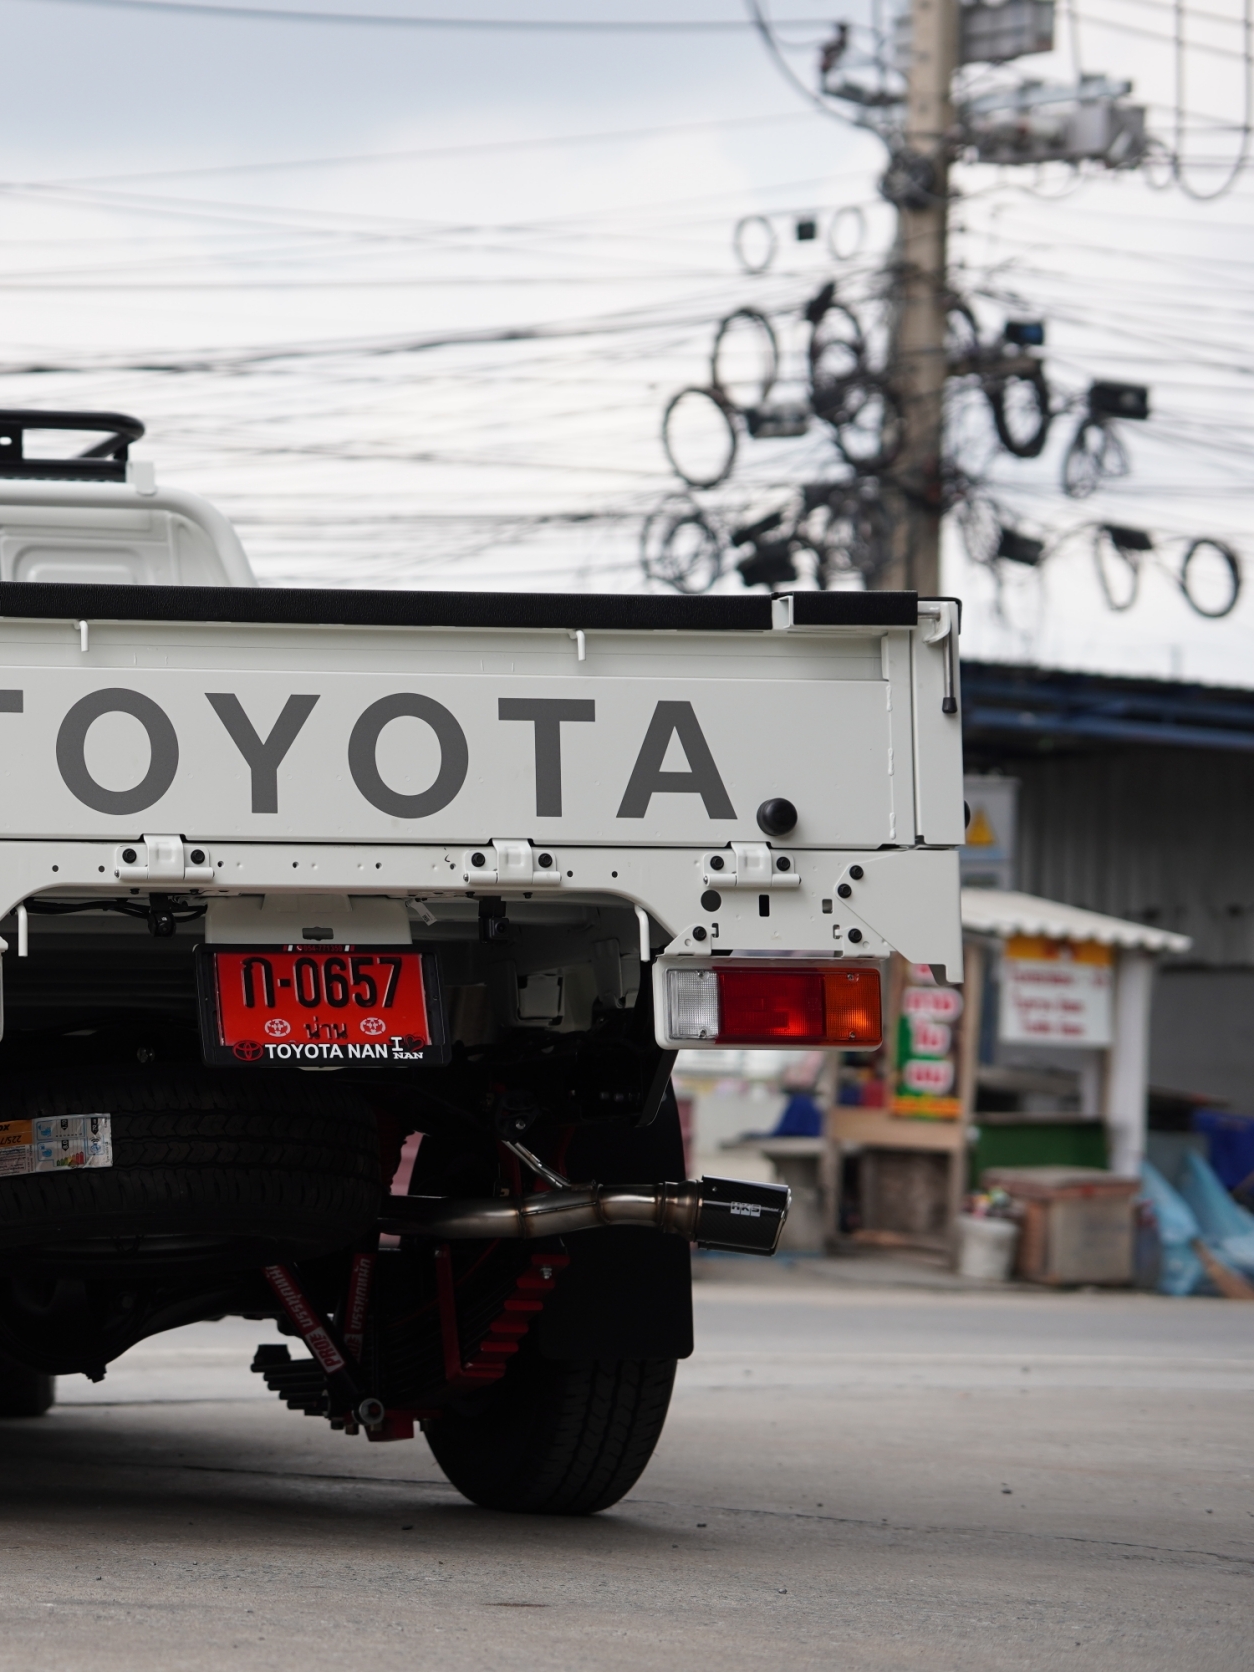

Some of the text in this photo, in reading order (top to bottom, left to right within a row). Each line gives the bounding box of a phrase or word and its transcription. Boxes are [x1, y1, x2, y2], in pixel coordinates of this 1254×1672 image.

[241, 956, 402, 1008] ก-0657
[302, 1016, 348, 1040] น่าน
[265, 1044, 388, 1060] TOYOTA NAN
[393, 1051, 424, 1060] NAN
[730, 1201, 762, 1216] HKS
